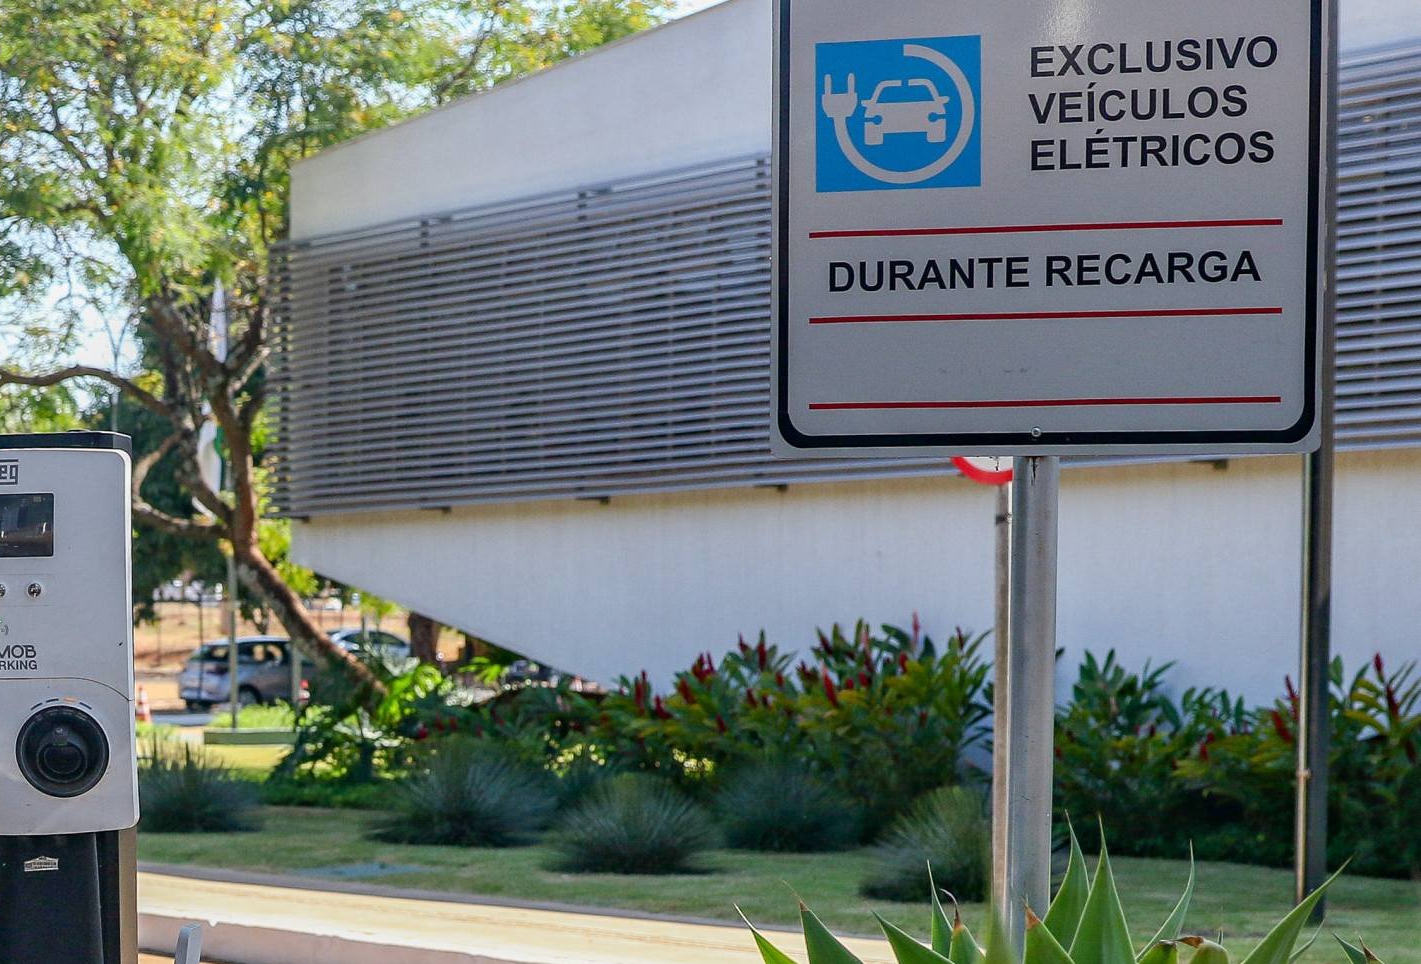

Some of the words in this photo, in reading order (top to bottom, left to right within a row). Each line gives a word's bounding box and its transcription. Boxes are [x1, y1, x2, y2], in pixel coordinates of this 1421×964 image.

[1030, 35, 1278, 78] EXCLUSIVO
[1028, 81, 1248, 124] VEÍCULOS
[1030, 128, 1275, 171] ELÉTRICOS
[828, 256, 1030, 292] DURANTE
[1045, 250, 1262, 287] RECARGA
